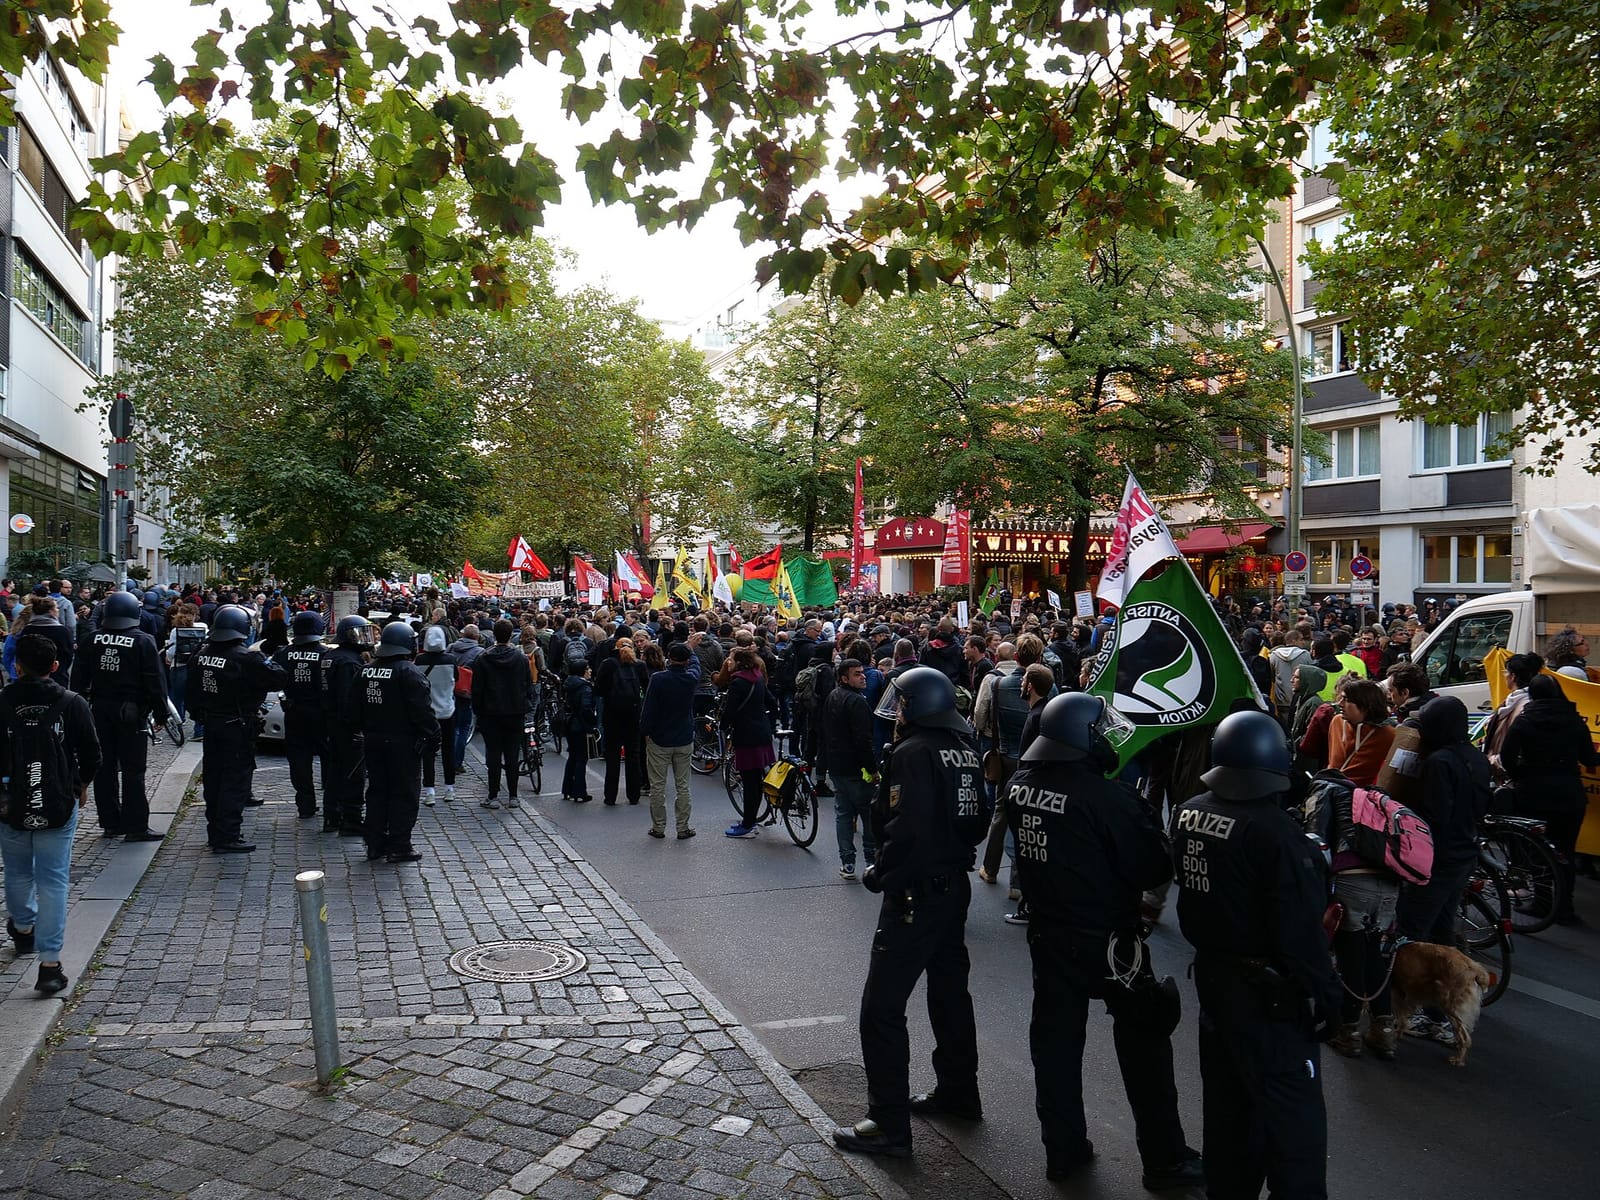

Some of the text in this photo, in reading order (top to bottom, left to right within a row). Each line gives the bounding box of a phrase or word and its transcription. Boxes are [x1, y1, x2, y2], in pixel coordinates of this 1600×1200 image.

[93, 633, 135, 648] POLIZEI
[105, 648, 118, 656] BP
[287, 651, 320, 661] POLIZEI
[100, 662, 120, 672] 2101
[197, 655, 227, 669] POLIZEI
[361, 667, 393, 679] POLIZEI
[368, 680, 379, 689] BP
[961, 773, 973, 787] BP
[957, 787, 978, 802] BDÜ
[1008, 784, 1068, 815] POLIZEI
[957, 802, 979, 816] 2112
[1022, 813, 1042, 830] BP
[1177, 809, 1236, 840] POLIZEI
[1018, 827, 1048, 848] BDÜ
[1019, 843, 1048, 862] 2110
[1187, 839, 1205, 856] BP
[1182, 855, 1208, 875] BDÜ
[1184, 871, 1210, 893] 2110
